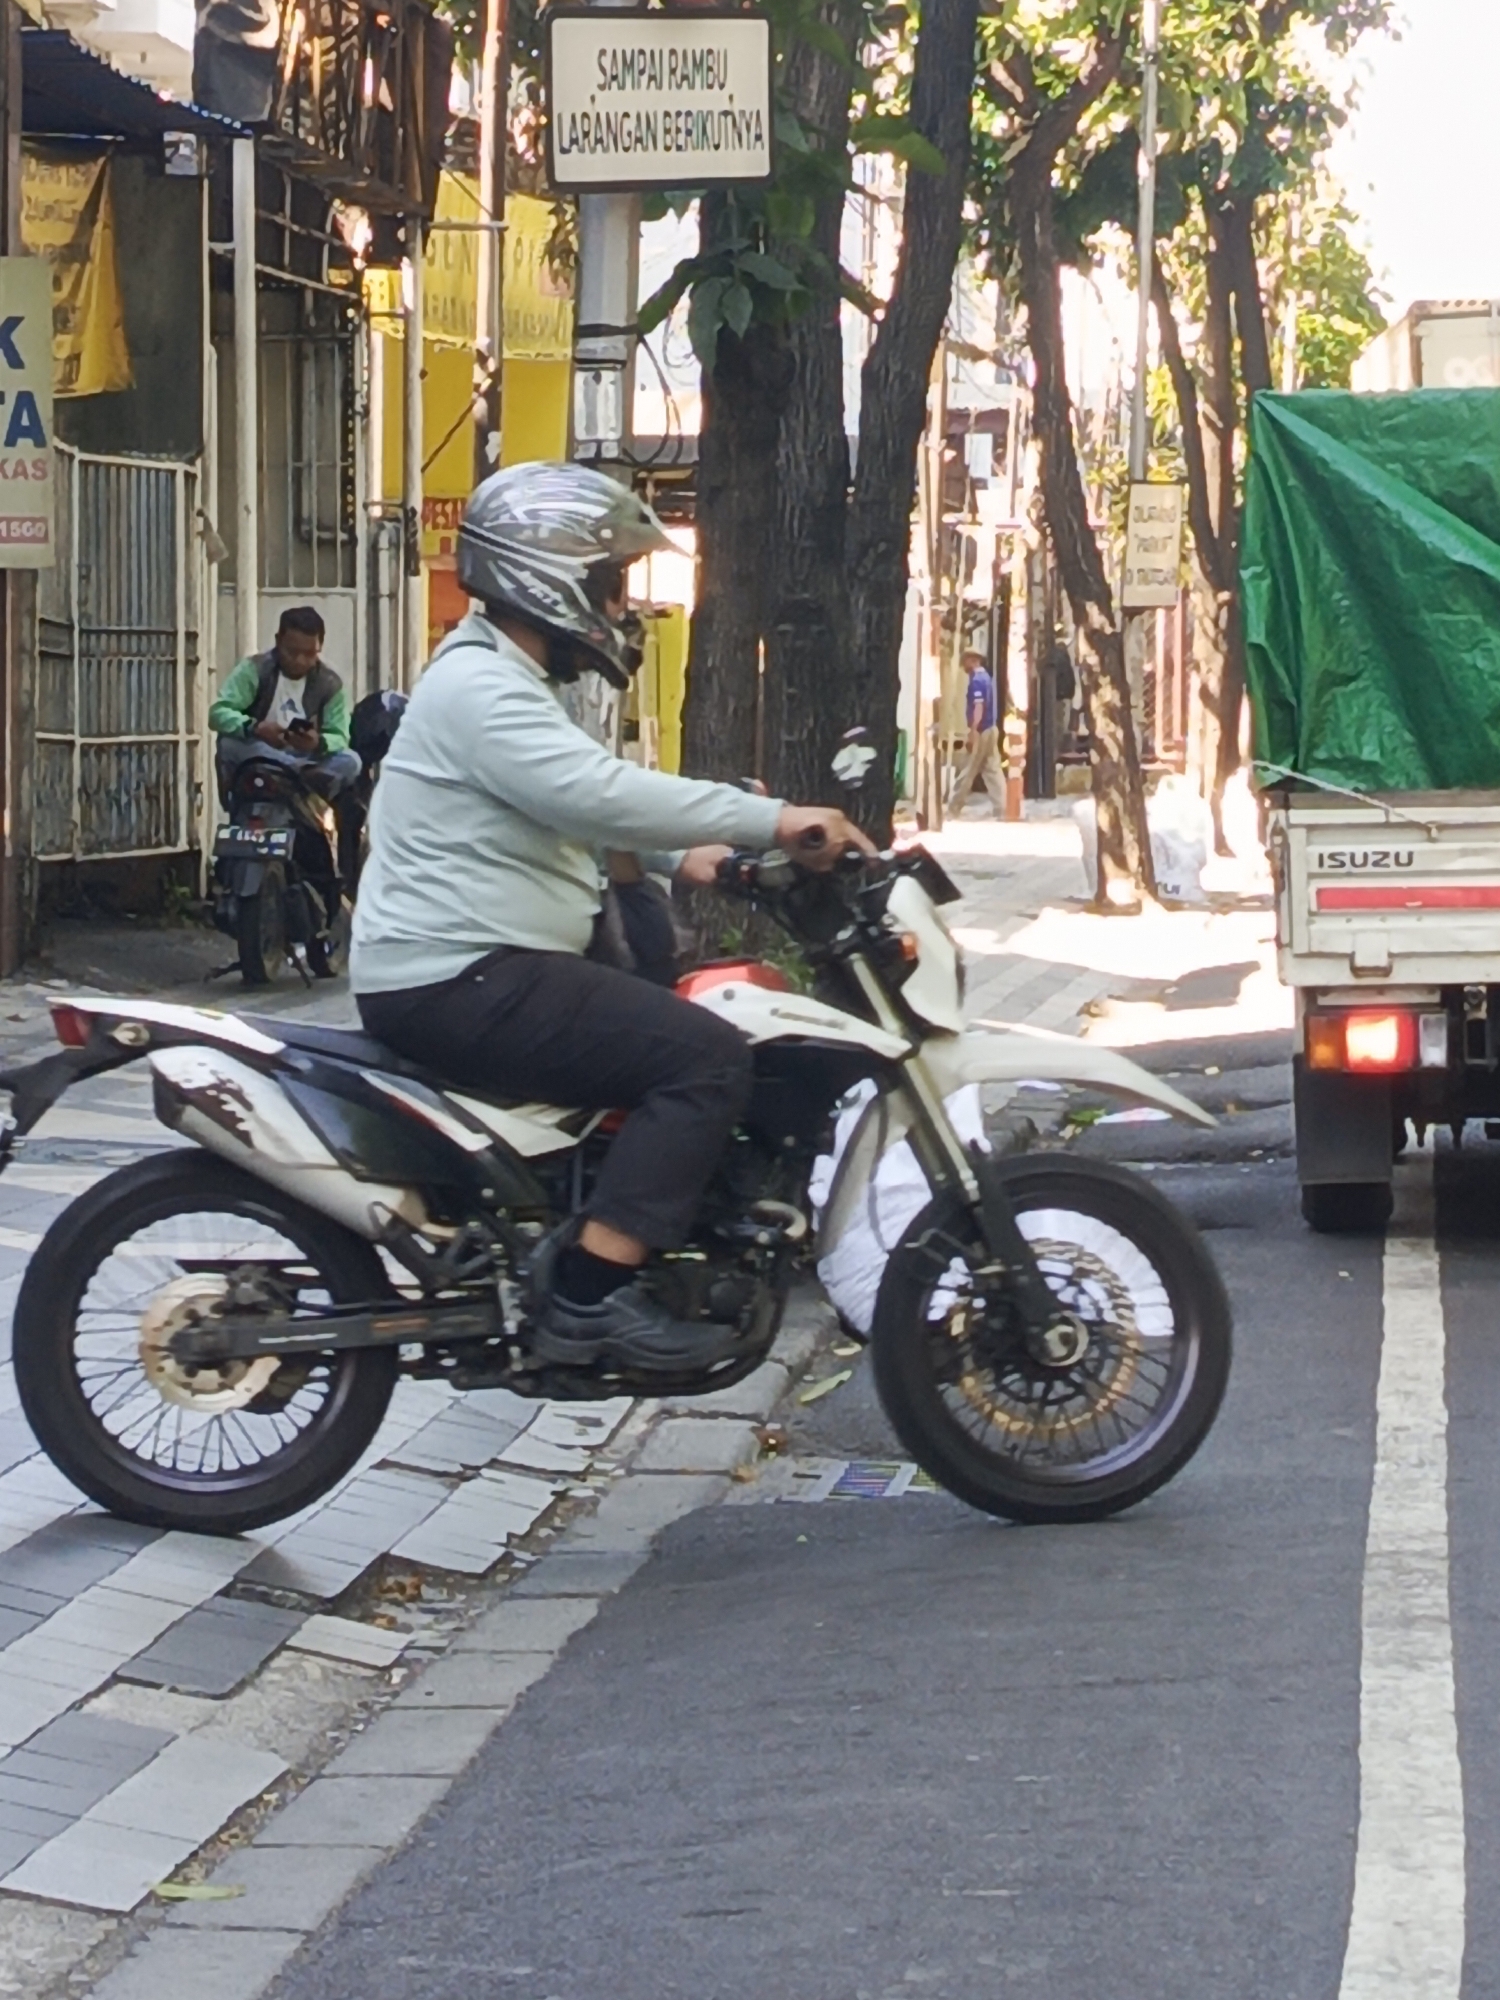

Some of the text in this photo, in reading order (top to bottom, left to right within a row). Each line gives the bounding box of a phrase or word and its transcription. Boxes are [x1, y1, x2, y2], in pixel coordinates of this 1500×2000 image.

[597, 48, 728, 92] SAMPAI RAMBU
[557, 109, 765, 155] LARANGAN BERIKUTNYA
[1318, 851, 1414, 869] ISUZU
